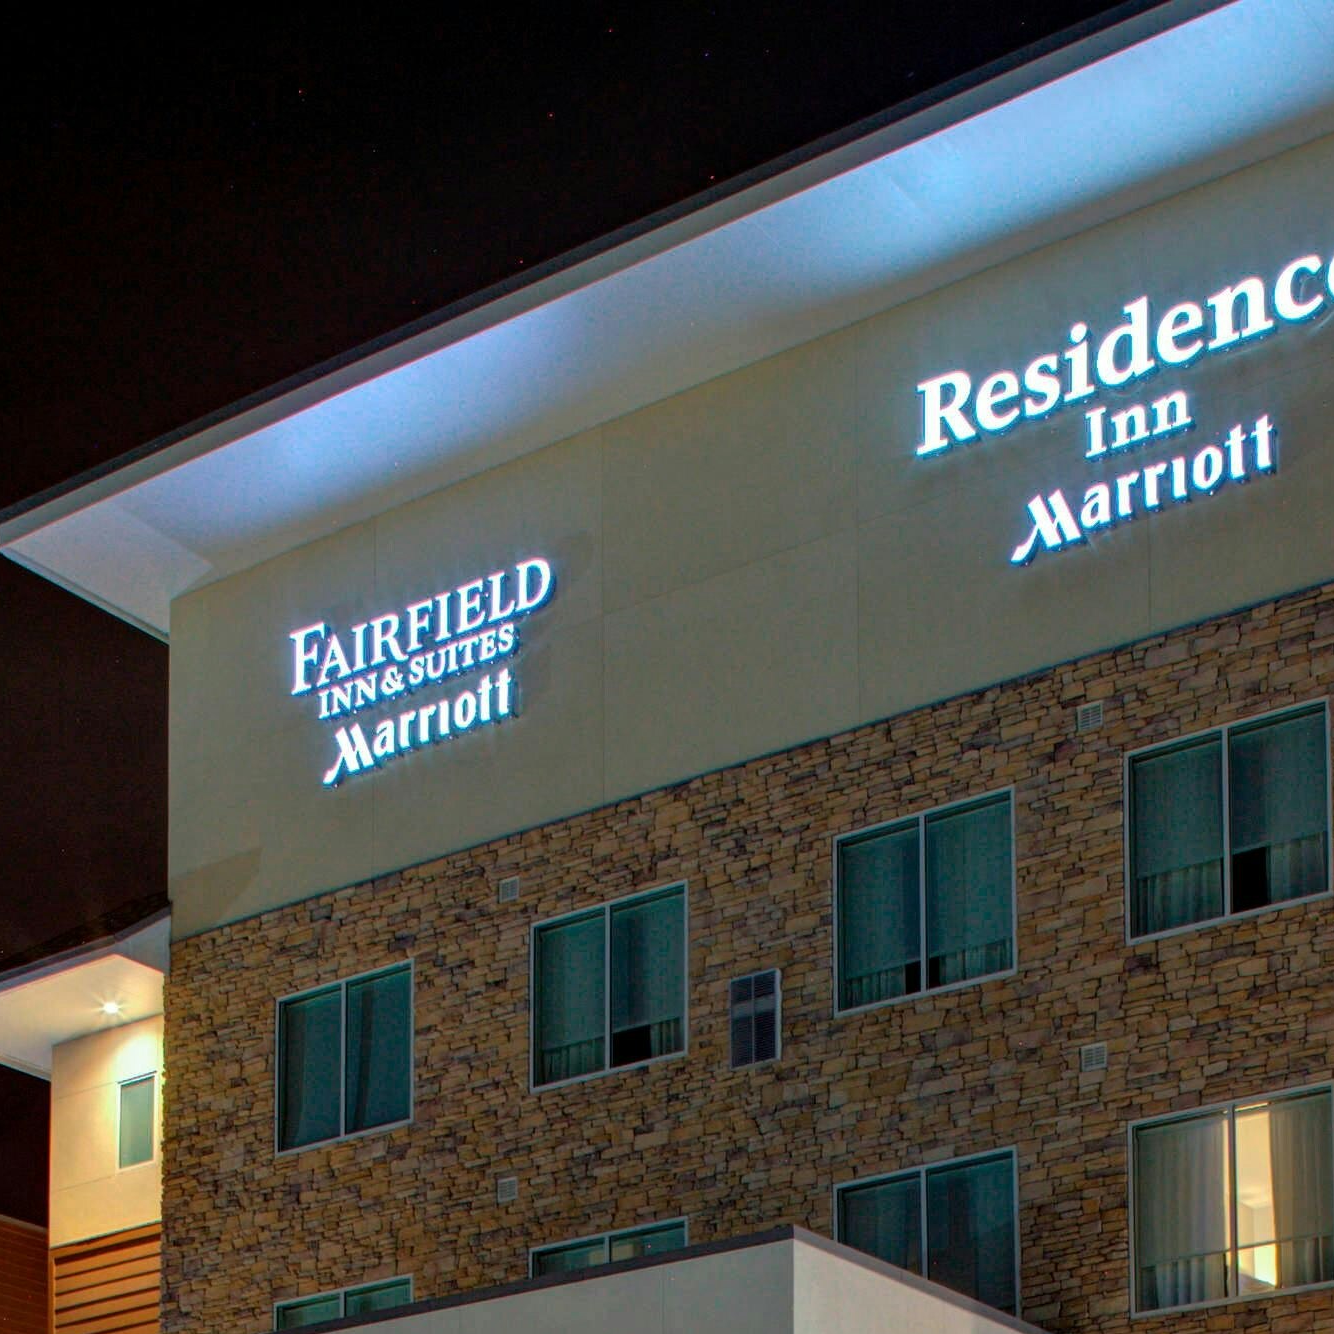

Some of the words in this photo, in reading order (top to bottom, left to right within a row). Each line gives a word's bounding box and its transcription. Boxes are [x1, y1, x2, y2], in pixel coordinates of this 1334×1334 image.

[1084, 390, 1193, 459] Inn
[1010, 414, 1276, 564] Marriott
[289, 557, 555, 696] FAIRFIELD
[409, 622, 516, 686] SUITES
[322, 667, 513, 786] Marriott
